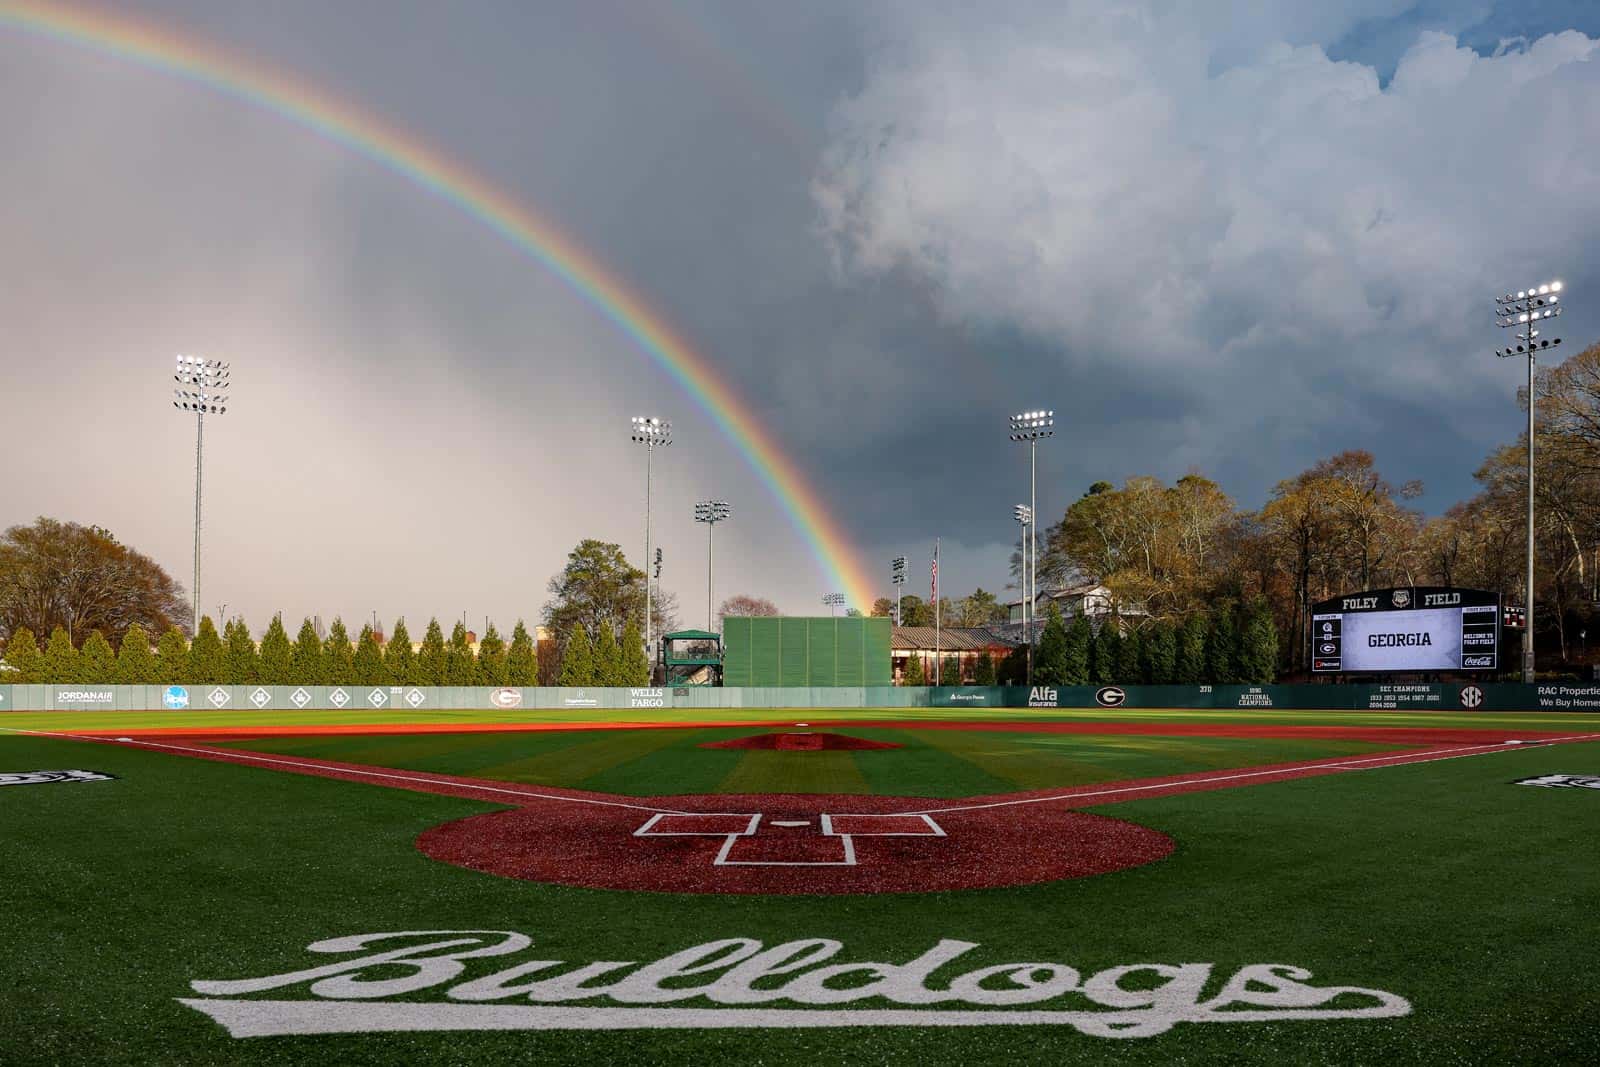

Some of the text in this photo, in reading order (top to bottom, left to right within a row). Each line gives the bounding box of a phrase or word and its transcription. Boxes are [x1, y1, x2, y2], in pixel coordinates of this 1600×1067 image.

[1342, 592, 1461, 610] FOLEY FIELD
[1368, 632, 1432, 648] GEORGIA
[631, 688, 663, 697] WELLS
[1030, 686, 1057, 701] Alfa
[1461, 686, 1482, 708] SEC
[1537, 686, 1557, 695] RAC
[631, 698, 664, 707] FARGO
[1540, 698, 1553, 706] We
[1555, 698, 1571, 709] Buy
[180, 929, 1412, 1041] Bulldogs
